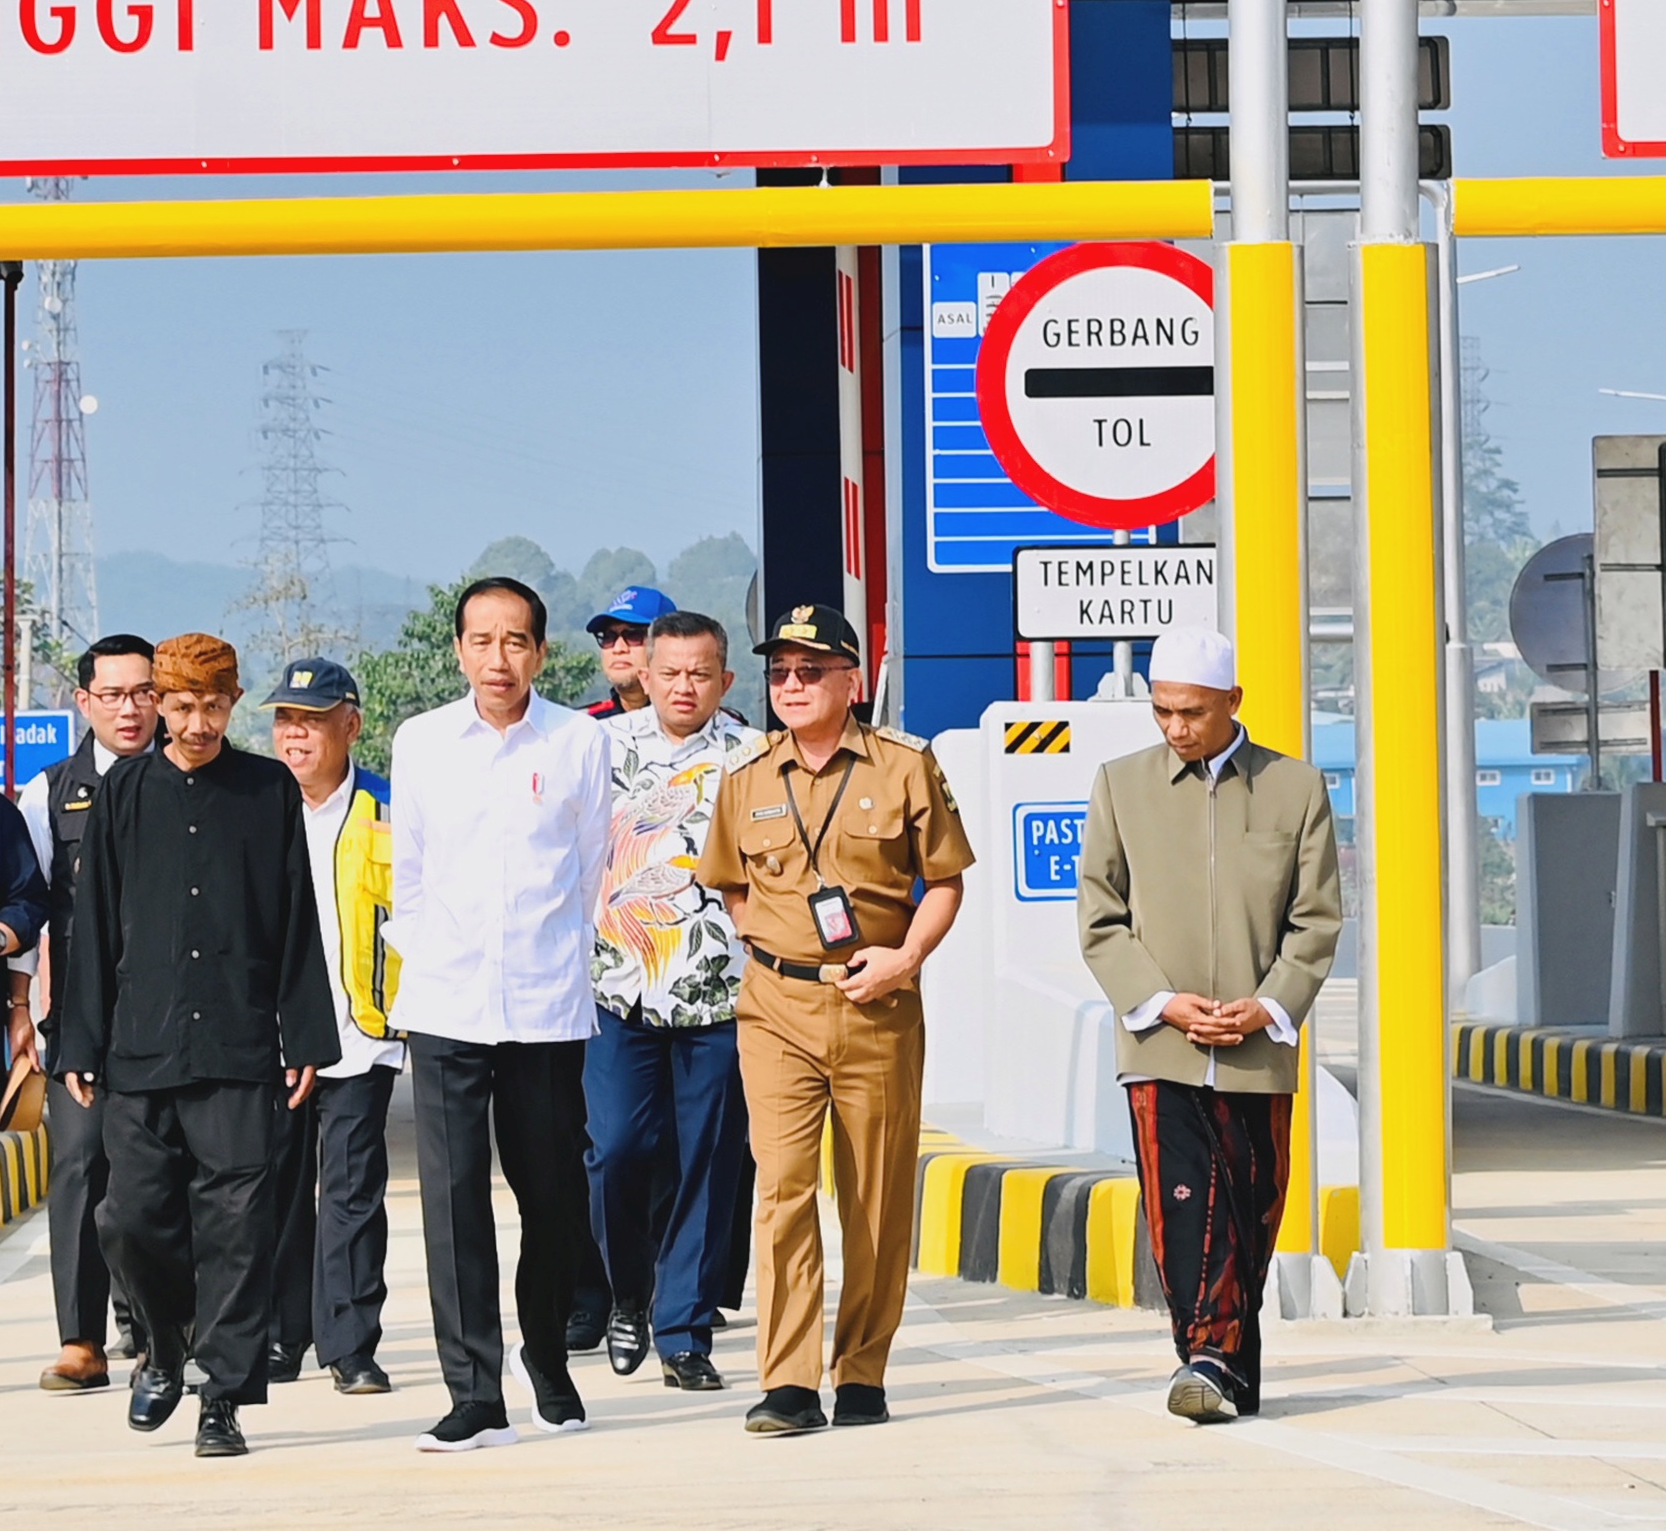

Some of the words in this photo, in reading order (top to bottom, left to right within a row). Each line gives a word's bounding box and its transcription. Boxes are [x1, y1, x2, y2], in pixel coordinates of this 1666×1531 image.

[937, 314, 973, 324] ASAL
[1042, 317, 1199, 348] GERBANG
[1093, 418, 1151, 447] TOL
[1039, 559, 1213, 587] TEMPELKAN
[1079, 599, 1173, 625] KARTU
[1032, 819, 1085, 845] PAST
[1050, 855, 1080, 881] E-T
